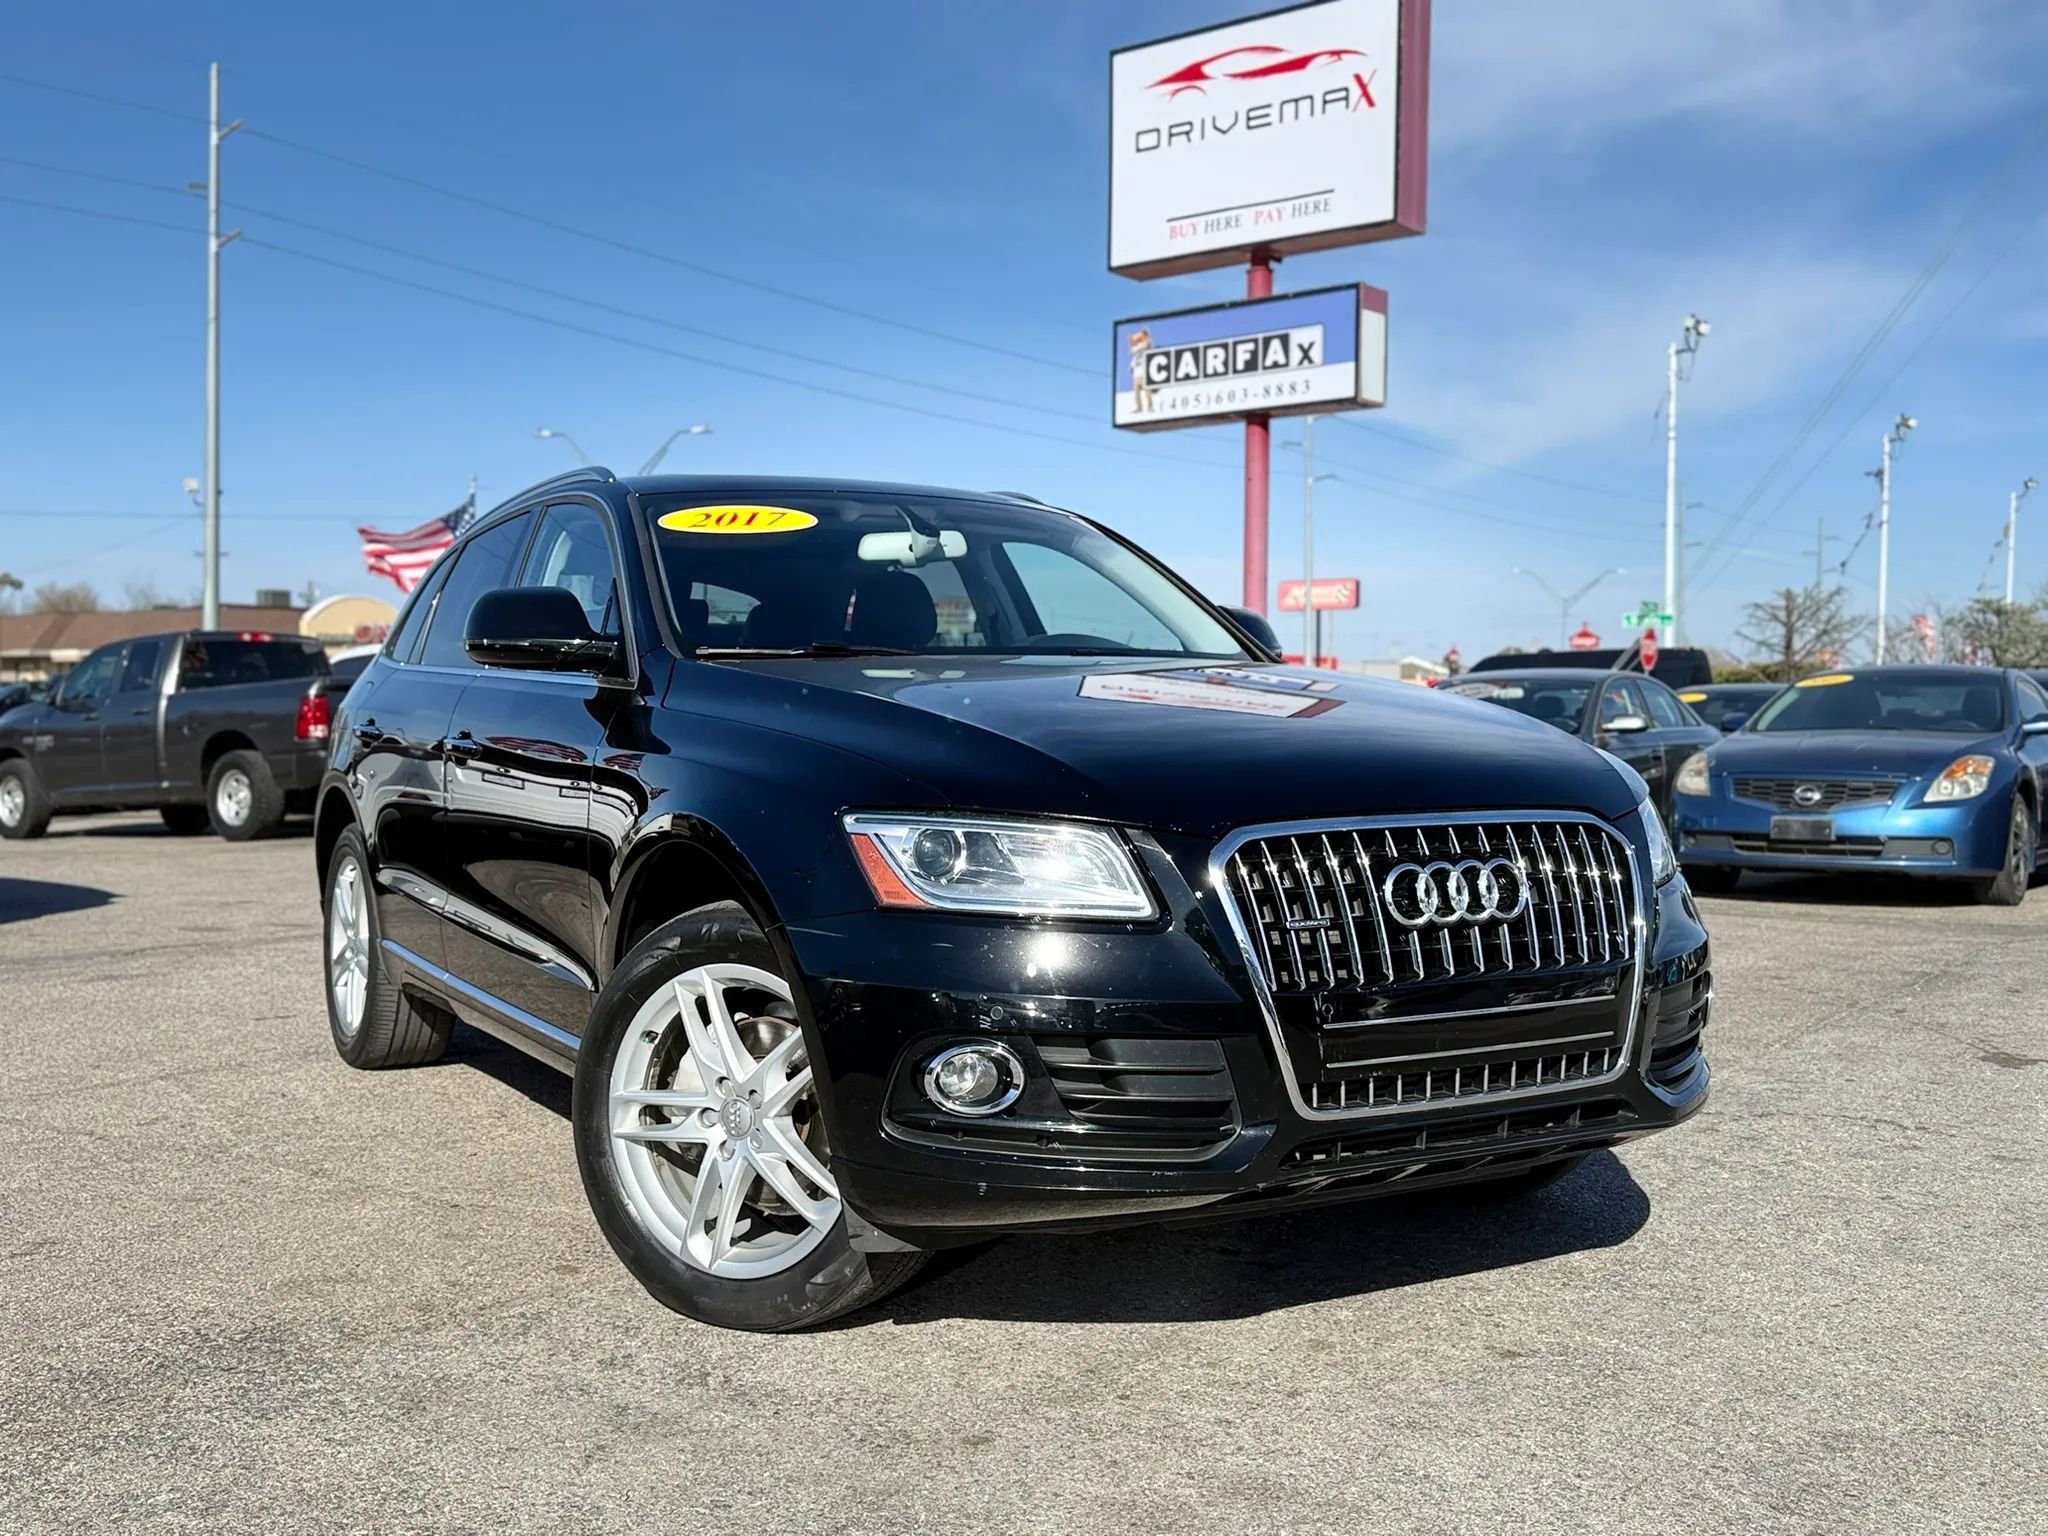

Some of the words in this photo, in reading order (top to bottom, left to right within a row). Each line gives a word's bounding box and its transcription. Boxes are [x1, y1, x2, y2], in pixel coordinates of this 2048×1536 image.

[1136, 68, 1377, 153] DRIVEMAX
[1169, 222, 1200, 240] BUY
[1203, 214, 1243, 234] HERE
[1254, 207, 1286, 225] PAY
[1291, 198, 1332, 218] HERE
[1148, 337, 1316, 383] CARFAX
[1158, 379, 1312, 413] (405)603-8883
[688, 511, 788, 528] 2017
